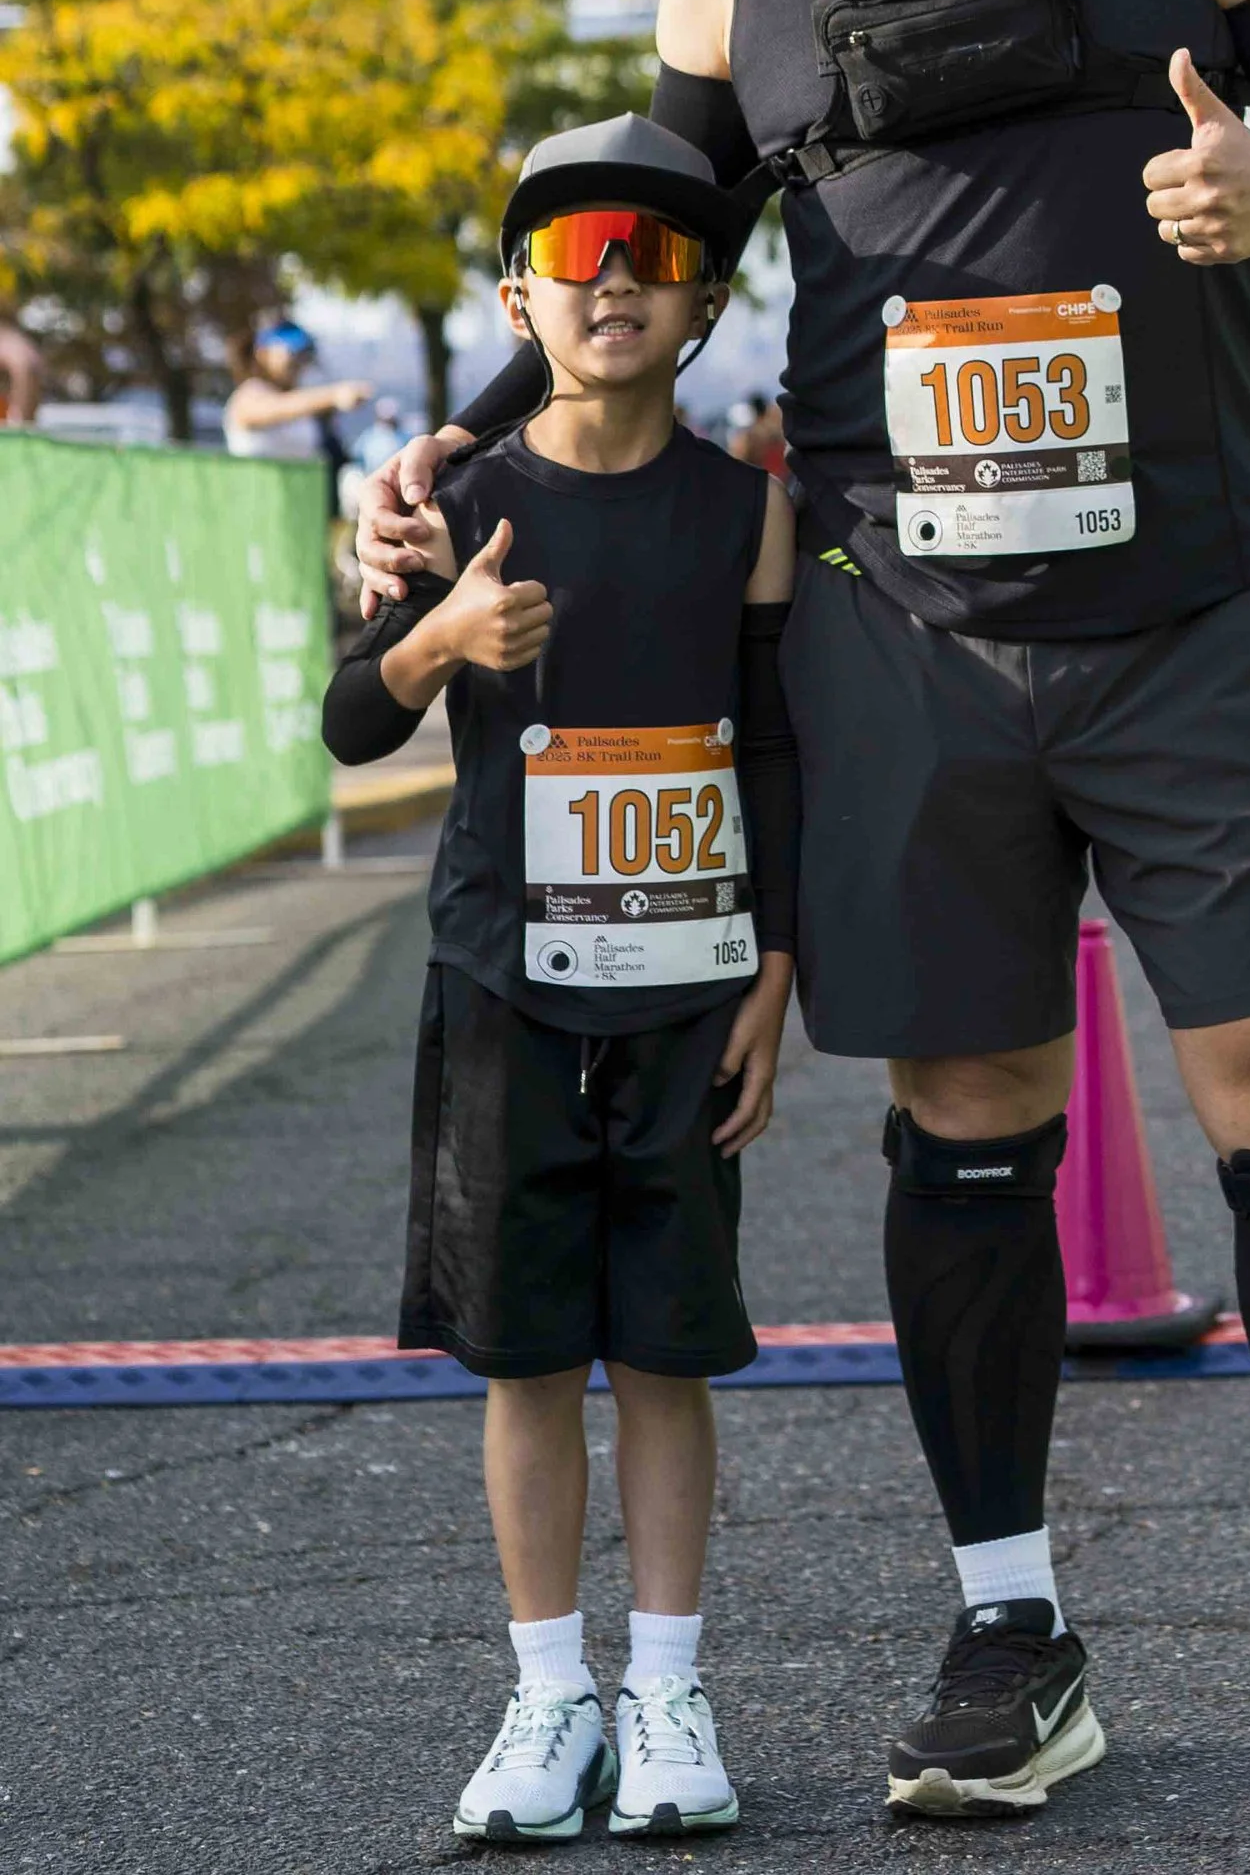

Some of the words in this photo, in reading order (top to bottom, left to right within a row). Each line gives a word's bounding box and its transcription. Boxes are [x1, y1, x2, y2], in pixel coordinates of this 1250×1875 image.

[924, 307, 980, 320] Palisades
[1057, 302, 1096, 316] CHPE
[944, 322, 973, 334] Trail
[977, 321, 1004, 332] Run
[920, 353, 1091, 447] 1053
[1075, 508, 1121, 535] 1053
[576, 736, 640, 747] Palisades
[576, 751, 596, 762] 8K
[600, 750, 631, 762] Trail
[635, 751, 662, 762] Run
[568, 783, 727, 877] 1052
[545, 895, 592, 905] Palisades
[545, 913, 609, 923] Conservancy
[594, 943, 645, 954] Palisades
[713, 939, 748, 966] 1052
[594, 953, 617, 963] Half
[594, 962, 645, 972] Marathon
